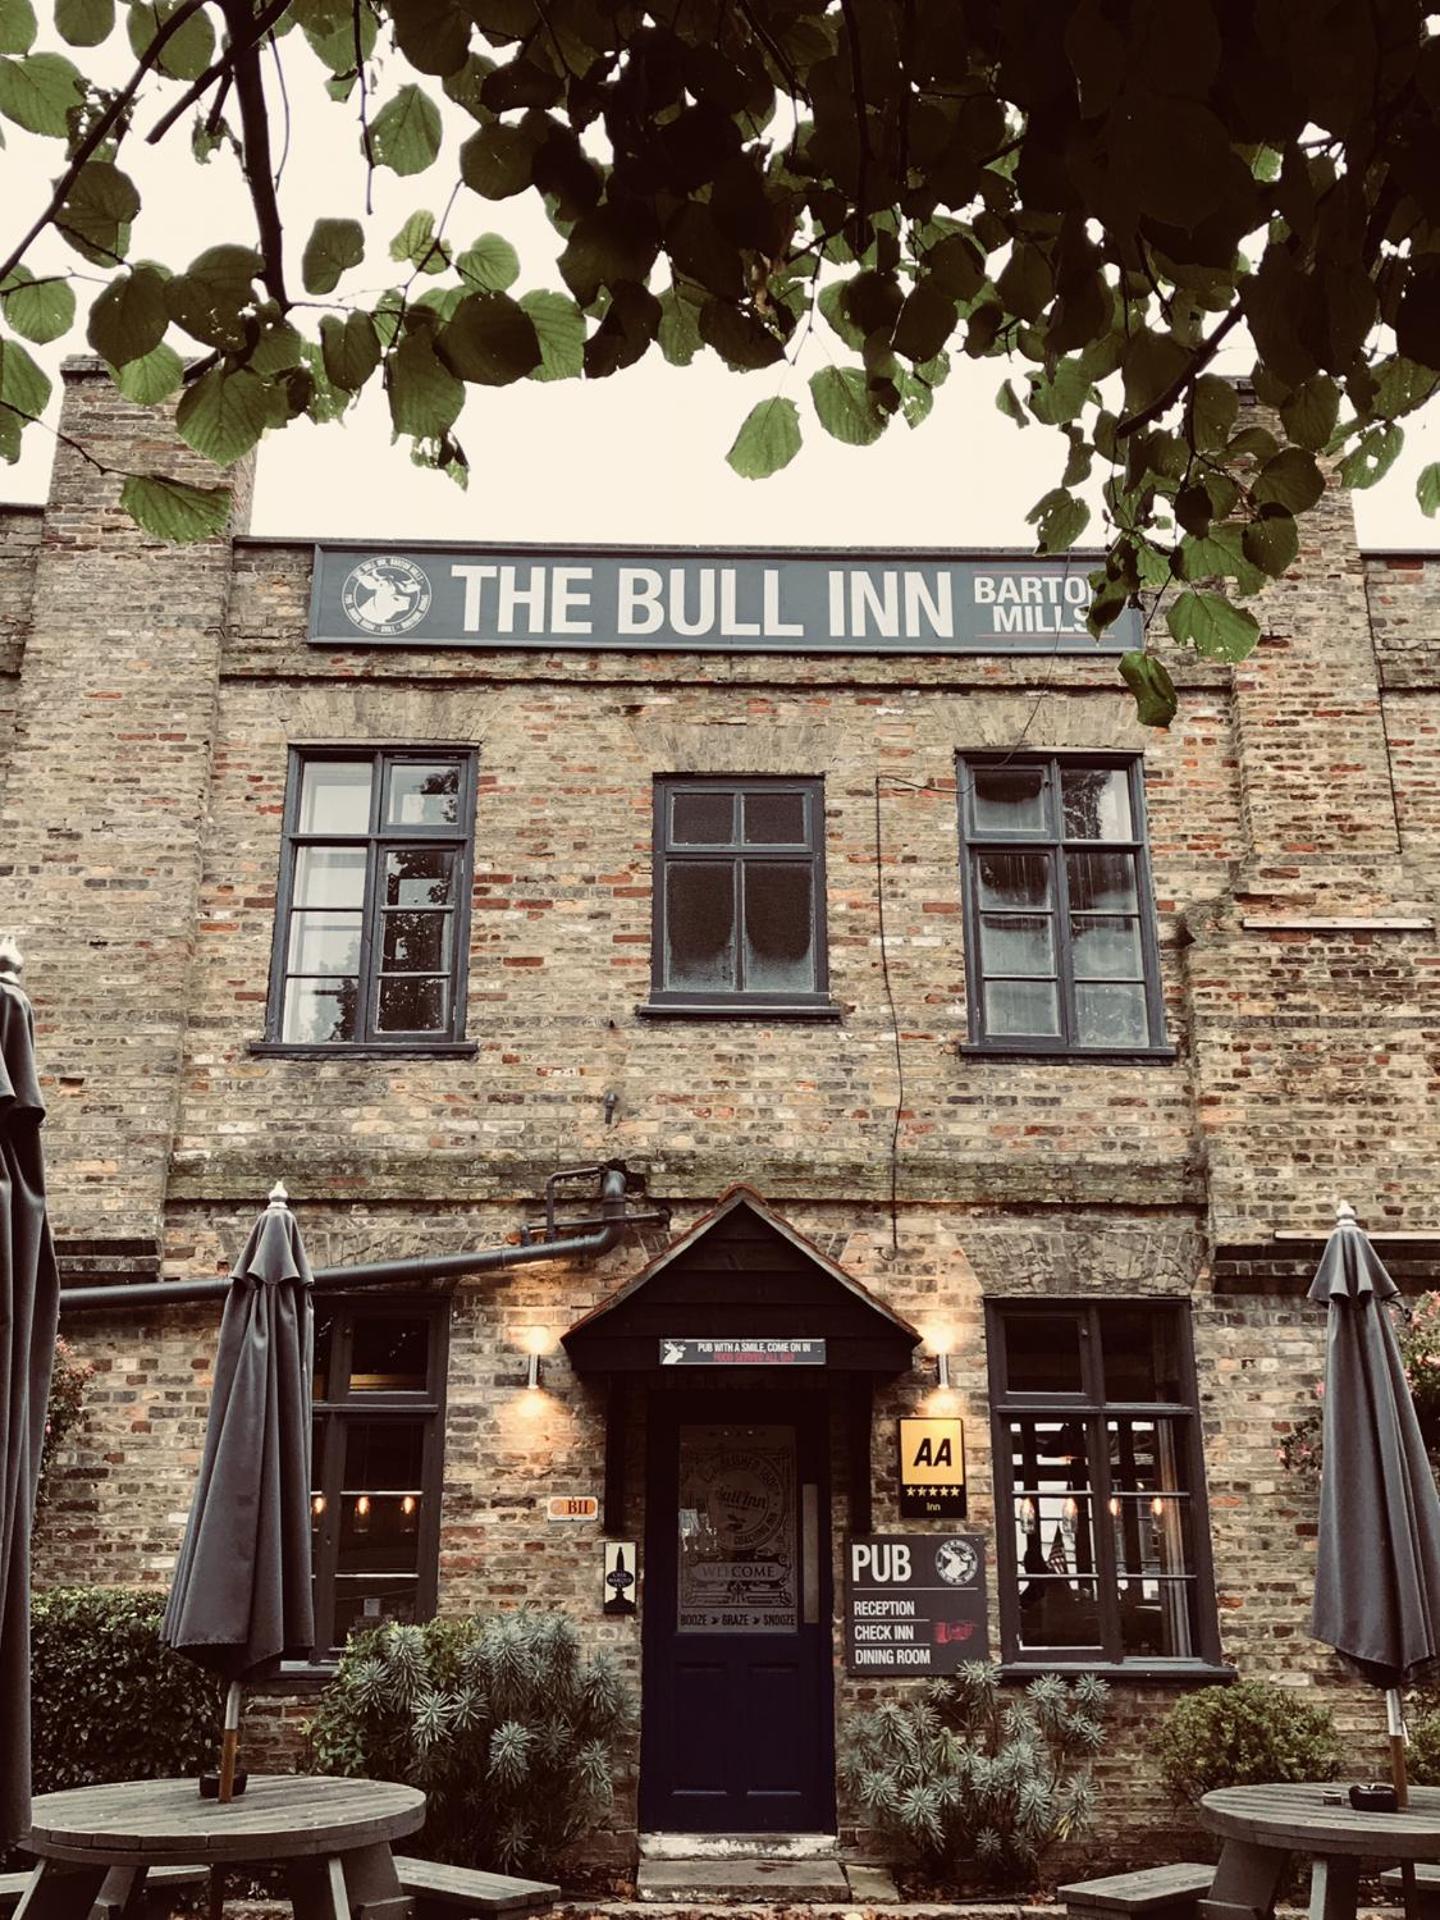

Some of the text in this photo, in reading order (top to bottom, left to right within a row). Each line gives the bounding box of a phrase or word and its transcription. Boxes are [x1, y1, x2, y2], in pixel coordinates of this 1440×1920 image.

[974, 576, 1093, 604] BARTO
[451, 564, 593, 634] THE
[617, 567, 804, 636] BULL
[828, 570, 954, 638] INN
[698, 1342, 713, 1353] PUB
[714, 1342, 734, 1353] WITH
[734, 1342, 741, 1353] A
[767, 1342, 789, 1353] COME
[790, 1342, 802, 1353] ON
[804, 1342, 811, 1353] IN
[913, 1438, 952, 1467] AA
[568, 1500, 588, 1514] BII
[926, 1502, 941, 1512] Inn
[851, 1544, 912, 1582] PUB
[854, 1601, 915, 1616] RECEPTION
[681, 1614, 795, 1626] BOOZE GRAZE SNOOZE
[854, 1625, 914, 1641] CHECK INN
[855, 1649, 931, 1665] DINING ROOM
